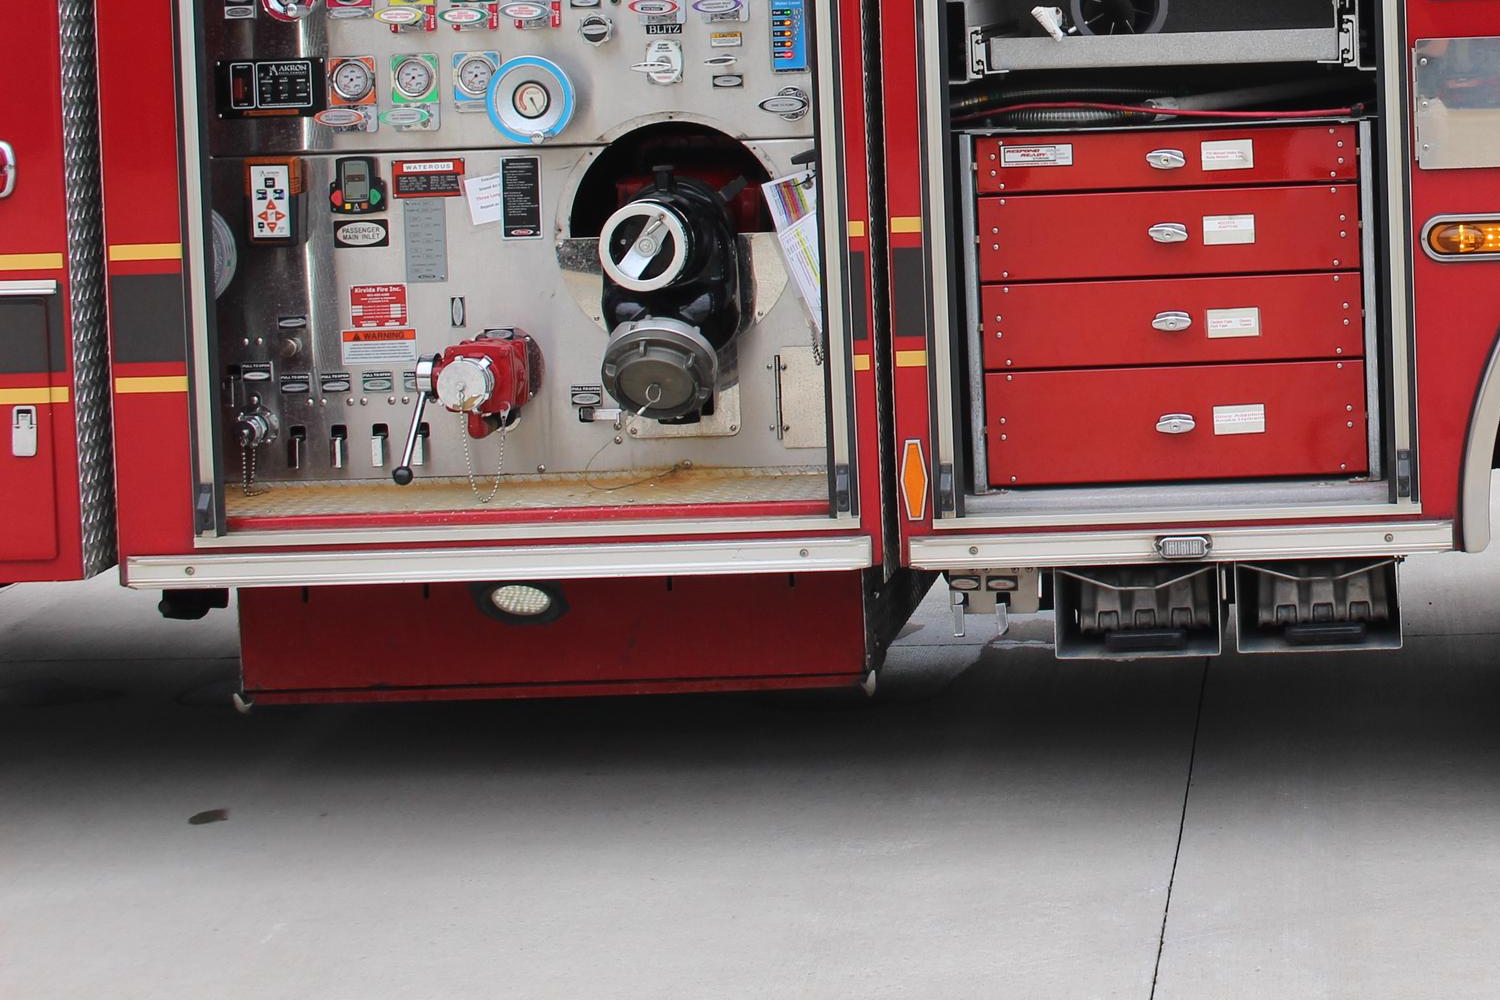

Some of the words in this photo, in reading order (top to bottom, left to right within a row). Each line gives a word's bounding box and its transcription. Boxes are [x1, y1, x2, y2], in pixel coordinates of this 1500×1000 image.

[649, 25, 681, 34] BLITZ
[279, 64, 307, 72] AKRON
[406, 163, 451, 171] WATEROUS
[364, 331, 405, 340] WARNING
